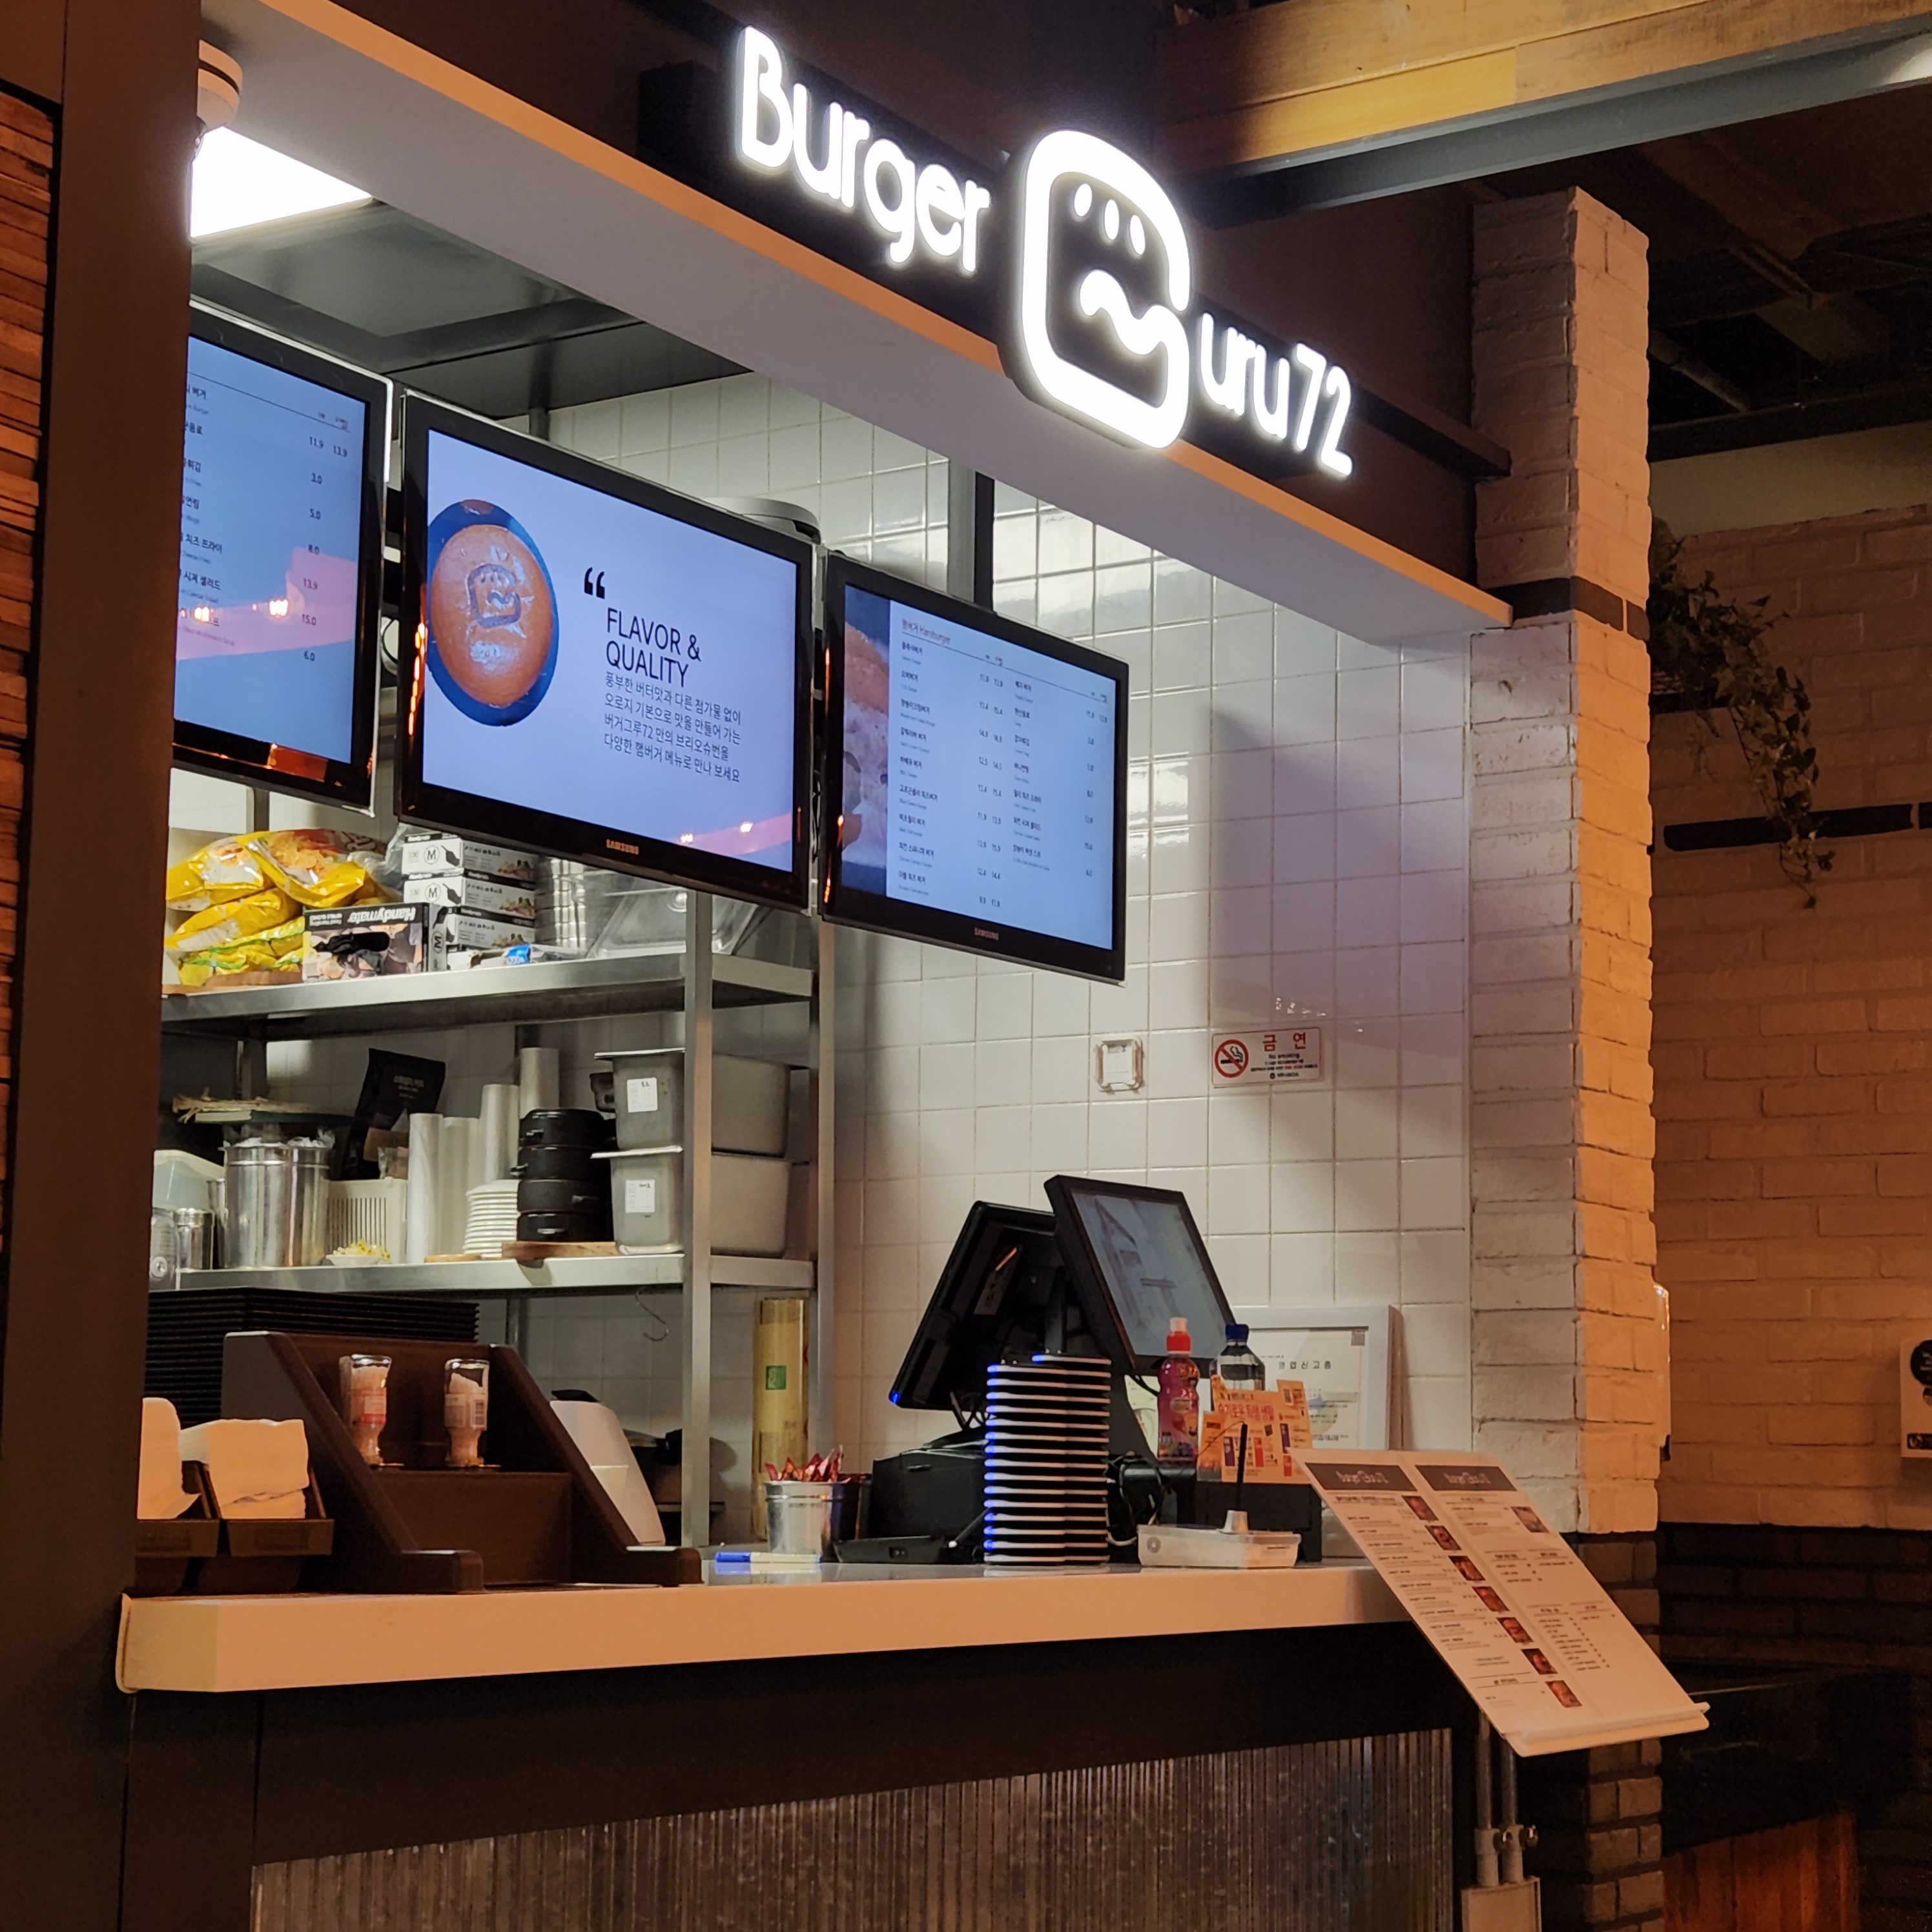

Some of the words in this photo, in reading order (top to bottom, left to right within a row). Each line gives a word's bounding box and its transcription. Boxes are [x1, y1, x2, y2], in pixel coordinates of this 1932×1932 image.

[738, 25, 991, 274] Burger
[185, 533, 200, 547] 치즈
[201, 539, 222, 554] 프라이
[607, 606, 681, 656] FLAVOR
[687, 633, 702, 663] &
[606, 640, 689, 688] QUALITY
[604, 692, 633, 714] 오로지
[635, 701, 672, 724] 기본으로
[674, 712, 692, 732] 맛을
[695, 718, 721, 740] 만들어
[723, 726, 741, 746] 가는
[605, 671, 633, 694] 풍부한
[635, 681, 672, 704] 버터맛과
[675, 693, 692, 711] 다른
[695, 698, 721, 720] 첨가물
[723, 706, 741, 726] 없이
[604, 733, 632, 755] 다양한
[635, 741, 663, 763] 햄버거
[664, 749, 692, 770] 메뉴로
[676, 733, 730, 762] 브리오슈번을
[346, 906, 416, 925] Handymate
